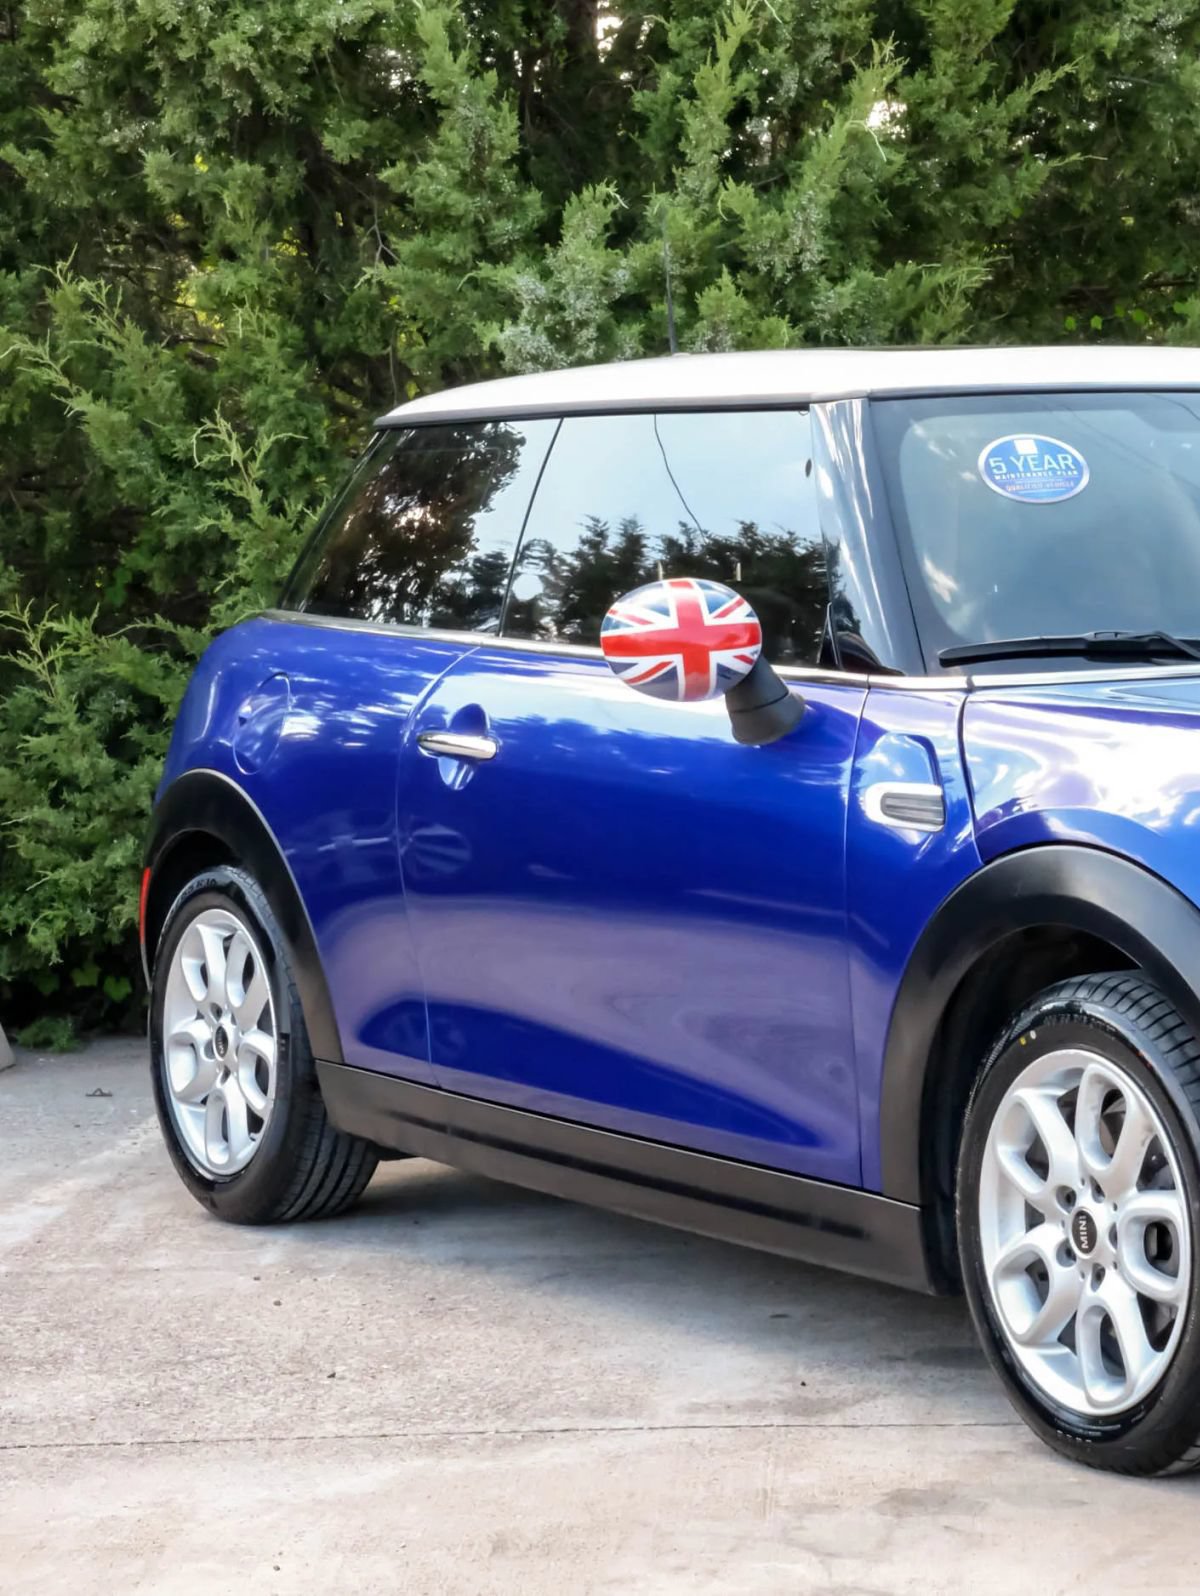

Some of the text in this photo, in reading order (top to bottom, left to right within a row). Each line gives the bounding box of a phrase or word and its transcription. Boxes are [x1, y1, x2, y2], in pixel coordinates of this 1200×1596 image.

[989, 454, 1076, 474] 5 YEAR
[994, 470, 1053, 480] MAINTENANCE
[1079, 1215, 1089, 1249] MINI
